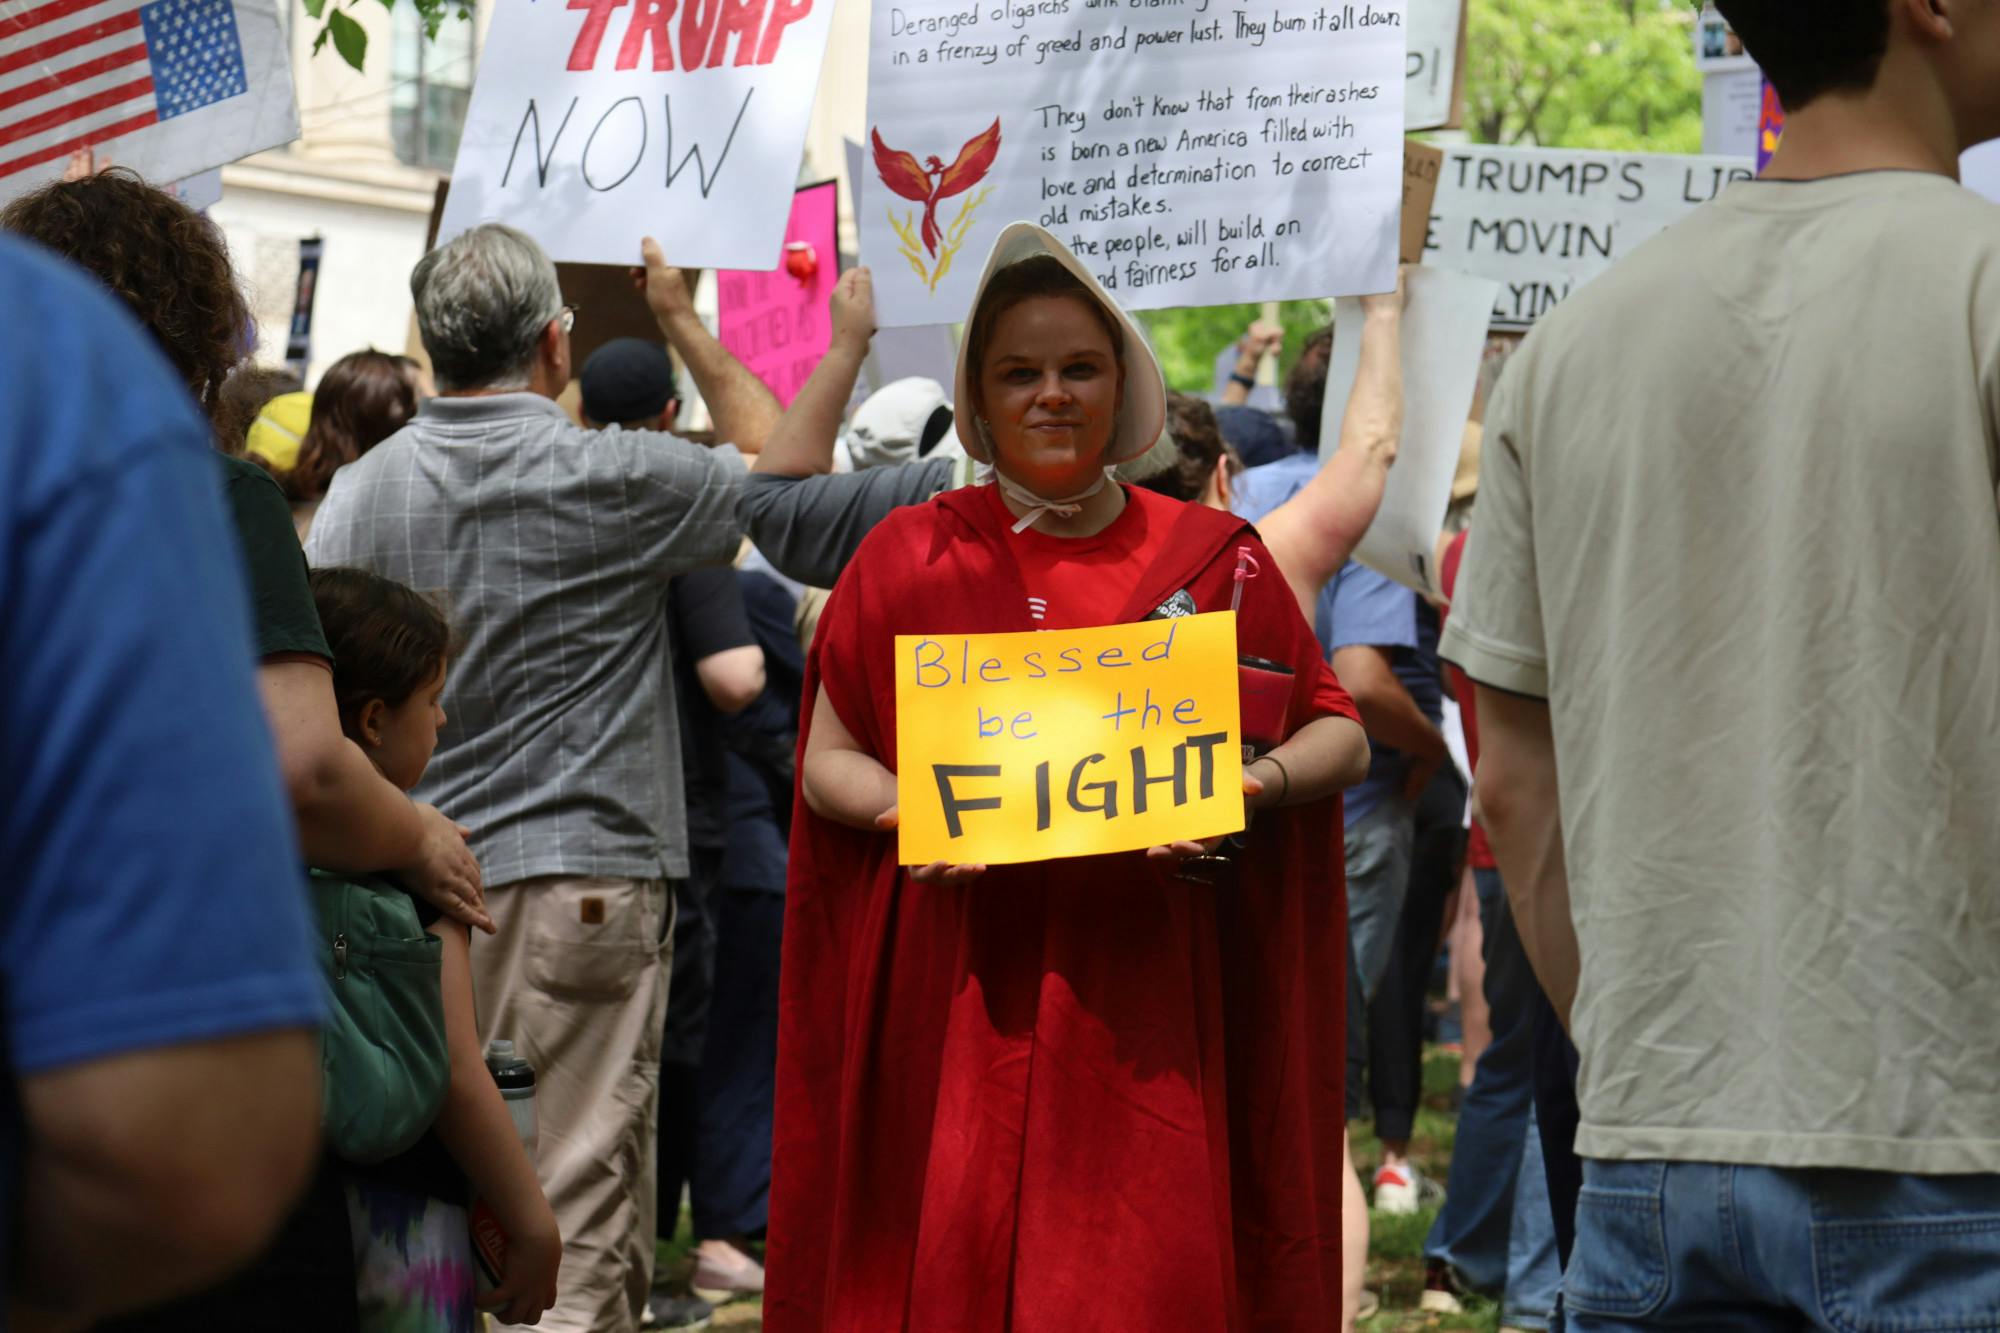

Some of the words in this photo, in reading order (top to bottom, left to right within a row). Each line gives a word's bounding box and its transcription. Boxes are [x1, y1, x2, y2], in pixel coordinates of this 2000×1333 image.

[566, 0, 814, 72] TRUMP
[891, 3, 979, 37] Deranged
[990, 0, 1070, 29] oligarchs
[892, 49, 910, 65] in
[917, 48, 929, 63] a
[936, 40, 999, 65] frenzy
[1005, 35, 1030, 57] of
[1036, 29, 1082, 64] greed
[1089, 26, 1128, 50] and
[1133, 29, 1185, 54] power
[1189, 18, 1224, 44] lust.
[1232, 9, 1267, 47] They
[1358, 4, 1401, 27] down
[1034, 104, 1086, 133] They
[1102, 95, 1145, 122] don't
[1196, 87, 1234, 112] that
[1246, 86, 1283, 111] from
[1287, 81, 1325, 107] their
[1325, 80, 1380, 104] ashes
[501, 86, 754, 199] NOW
[1041, 146, 1056, 162] is
[1071, 140, 1110, 162] born
[1116, 142, 1129, 157] a
[1135, 136, 1168, 154] new
[1176, 128, 1248, 152] America
[1260, 116, 1308, 143] filled
[1312, 114, 1354, 139] with
[1041, 177, 1078, 200] love
[1082, 169, 1116, 196] and
[1126, 156, 1257, 188] determination
[1271, 151, 1295, 176] to
[1301, 146, 1373, 172] correct
[1451, 155, 1646, 201] TRUMP'S
[1039, 205, 1069, 228] old
[1079, 193, 1173, 222] mistakes.
[1070, 234, 1099, 257] the
[1104, 225, 1170, 261] people,
[1176, 218, 1207, 248] will
[1218, 213, 1265, 242] build
[1274, 219, 1301, 237] on
[1467, 217, 1620, 257] MOVIN'
[1125, 260, 1198, 288] fairness
[1211, 246, 1244, 273] for
[1244, 241, 1281, 269] all.
[914, 622, 1178, 688] Blessed
[977, 706, 1038, 739] be
[1102, 688, 1202, 731] the
[932, 731, 1229, 839] FIGHT
